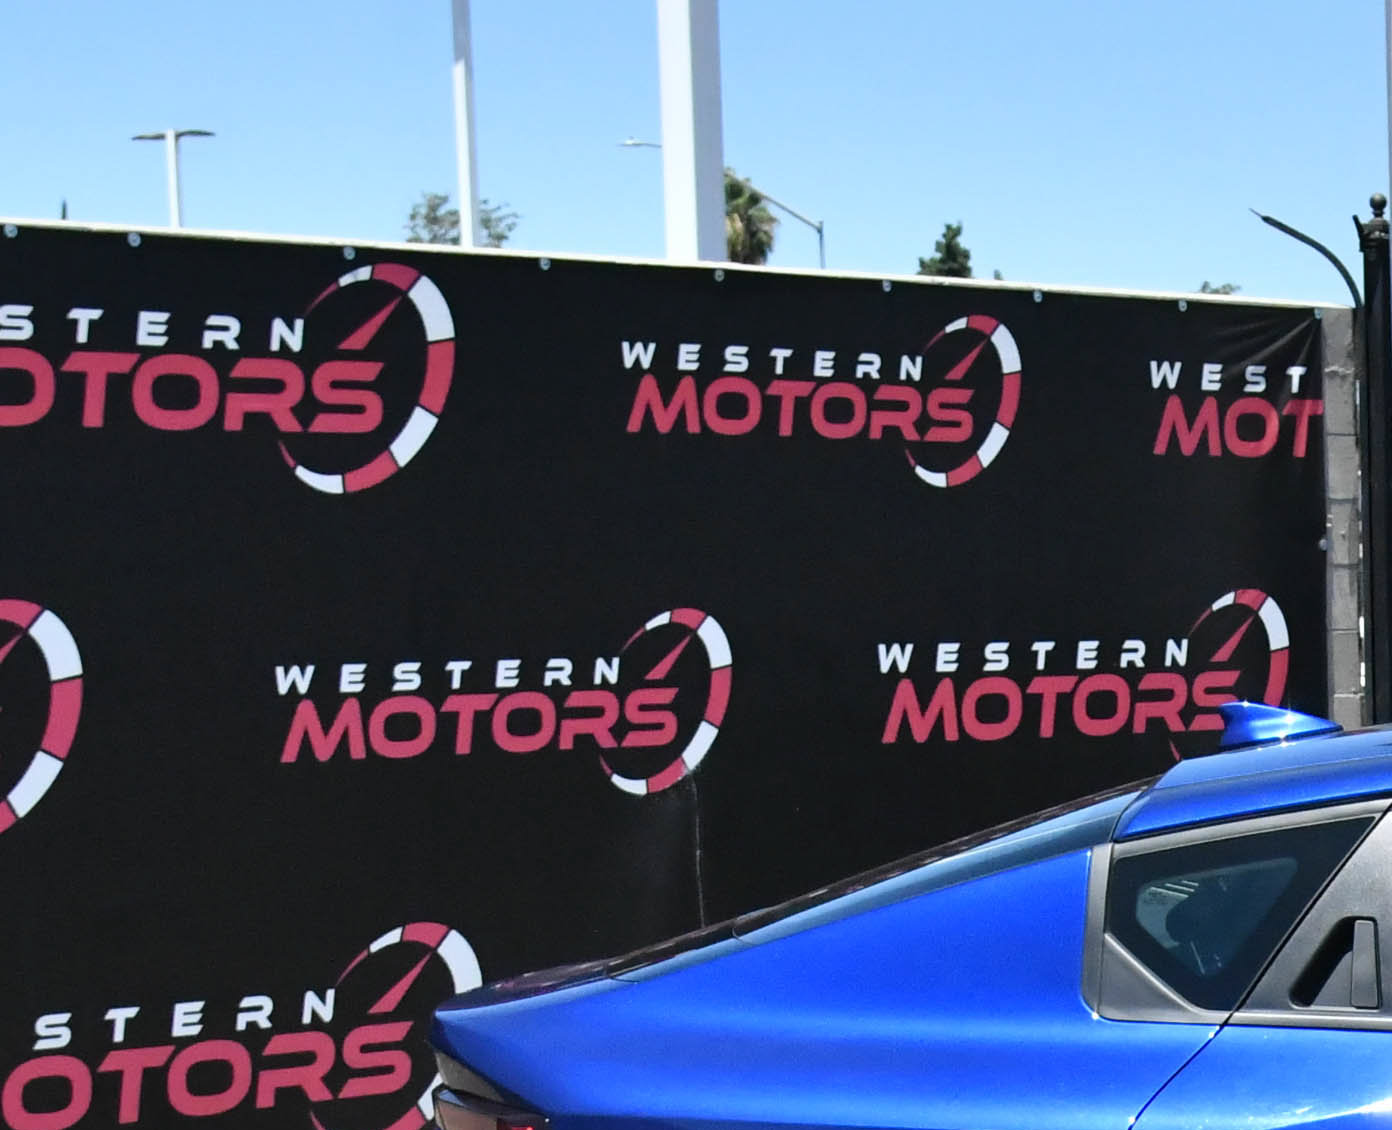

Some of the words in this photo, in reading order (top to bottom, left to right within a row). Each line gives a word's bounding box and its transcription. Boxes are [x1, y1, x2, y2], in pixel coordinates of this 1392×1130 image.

[621, 341, 923, 382] WESTERN
[1150, 360, 1307, 394] WEST
[626, 374, 974, 443] MOTORS
[1153, 395, 1324, 458] MOT
[275, 656, 620, 695] WESTERN
[877, 638, 1189, 674] WESTERN
[280, 687, 679, 763] MOTORS
[882, 670, 1242, 744] MOTORS
[33, 988, 336, 1051] STERN
